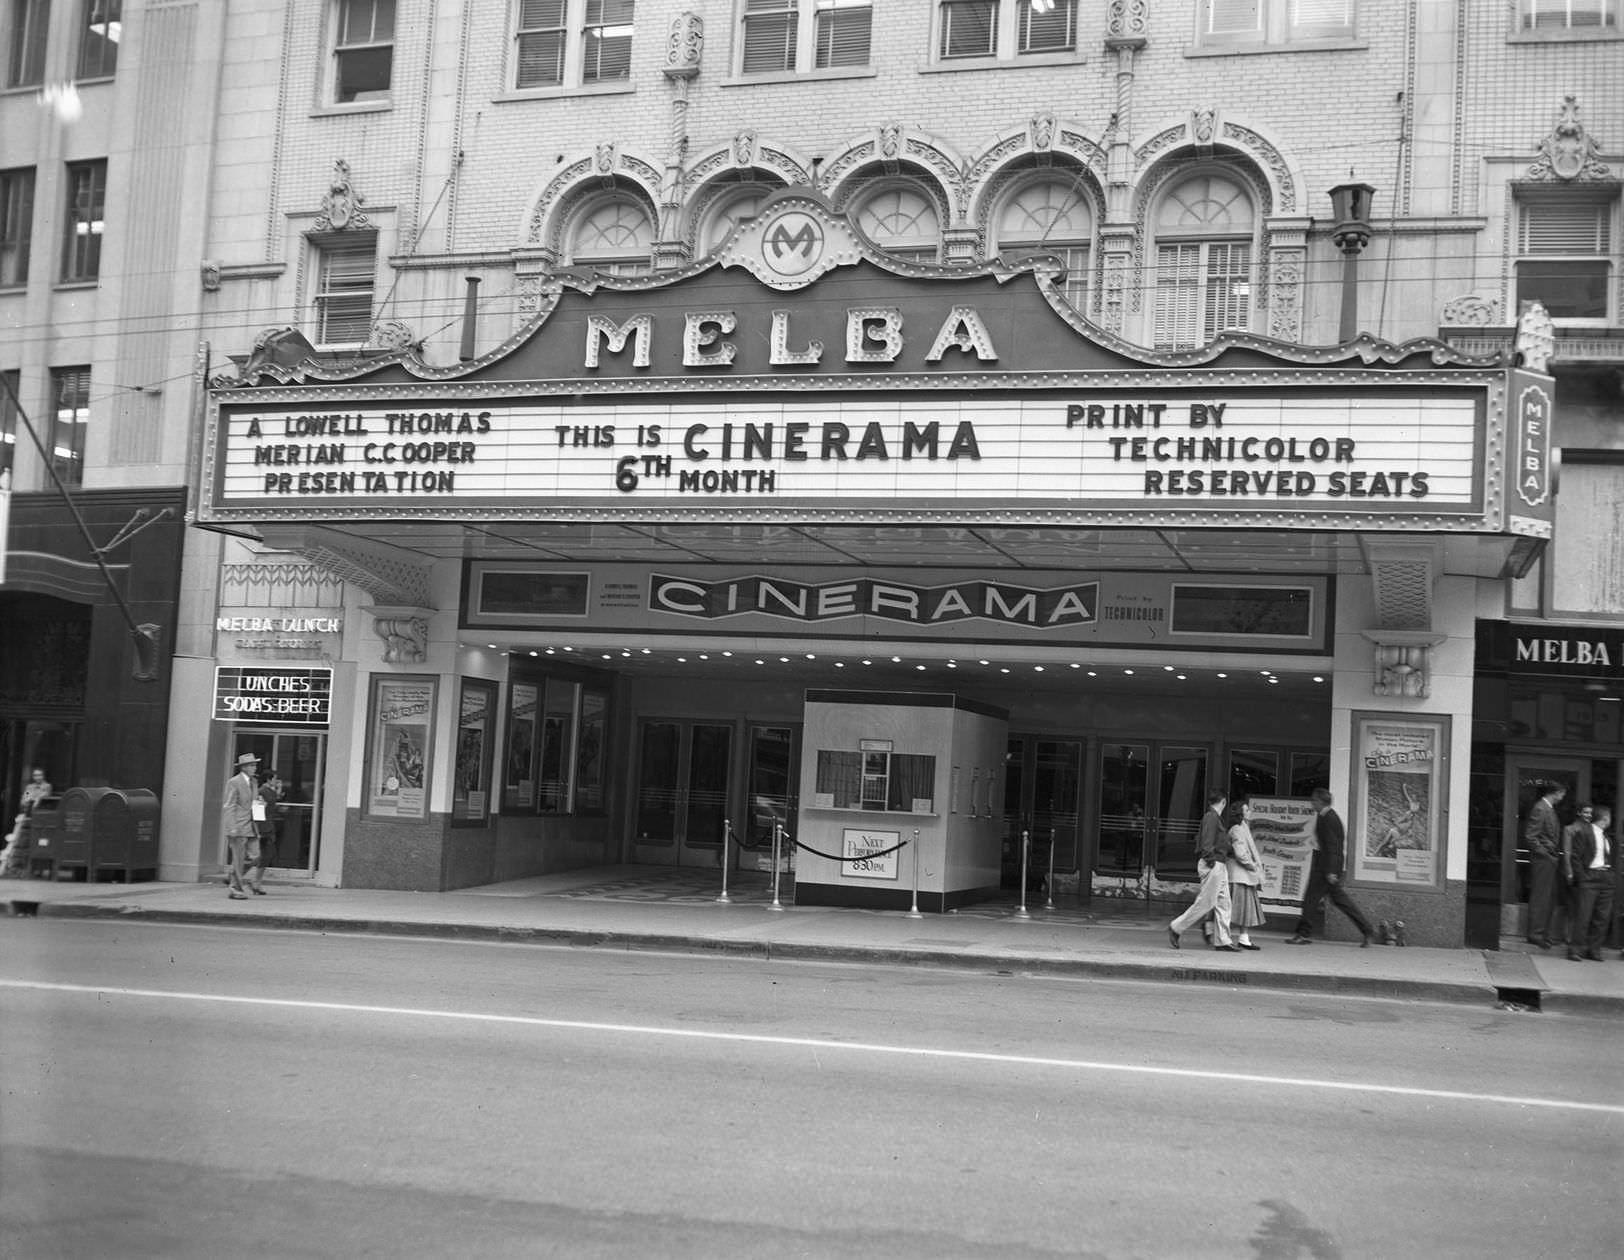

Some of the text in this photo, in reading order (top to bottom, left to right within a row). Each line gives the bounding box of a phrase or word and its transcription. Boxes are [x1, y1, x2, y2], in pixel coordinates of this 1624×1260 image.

[771, 222, 813, 259] M
[584, 304, 999, 369] MELBA
[247, 411, 491, 438] A LOWELL THOMAS
[1066, 402, 1227, 429] PRINT BY
[254, 443, 345, 466] MERIAN
[555, 421, 981, 461] THIS IS CINERAMA
[1108, 436, 1355, 463] TECHNICOLOR
[1524, 402, 1542, 490] MELBA
[264, 471, 454, 494] PRESENTATION
[616, 454, 776, 493] 6TH MONTH
[1145, 469, 1429, 498] RESERVED SEATS
[657, 581, 1090, 622] CINERAMA
[1104, 606, 1164, 621] TECHNICOLOR
[216, 617, 339, 633] MELBA LUNCH
[1515, 638, 1612, 666] MELBA
[238, 675, 311, 692] LUNCHES
